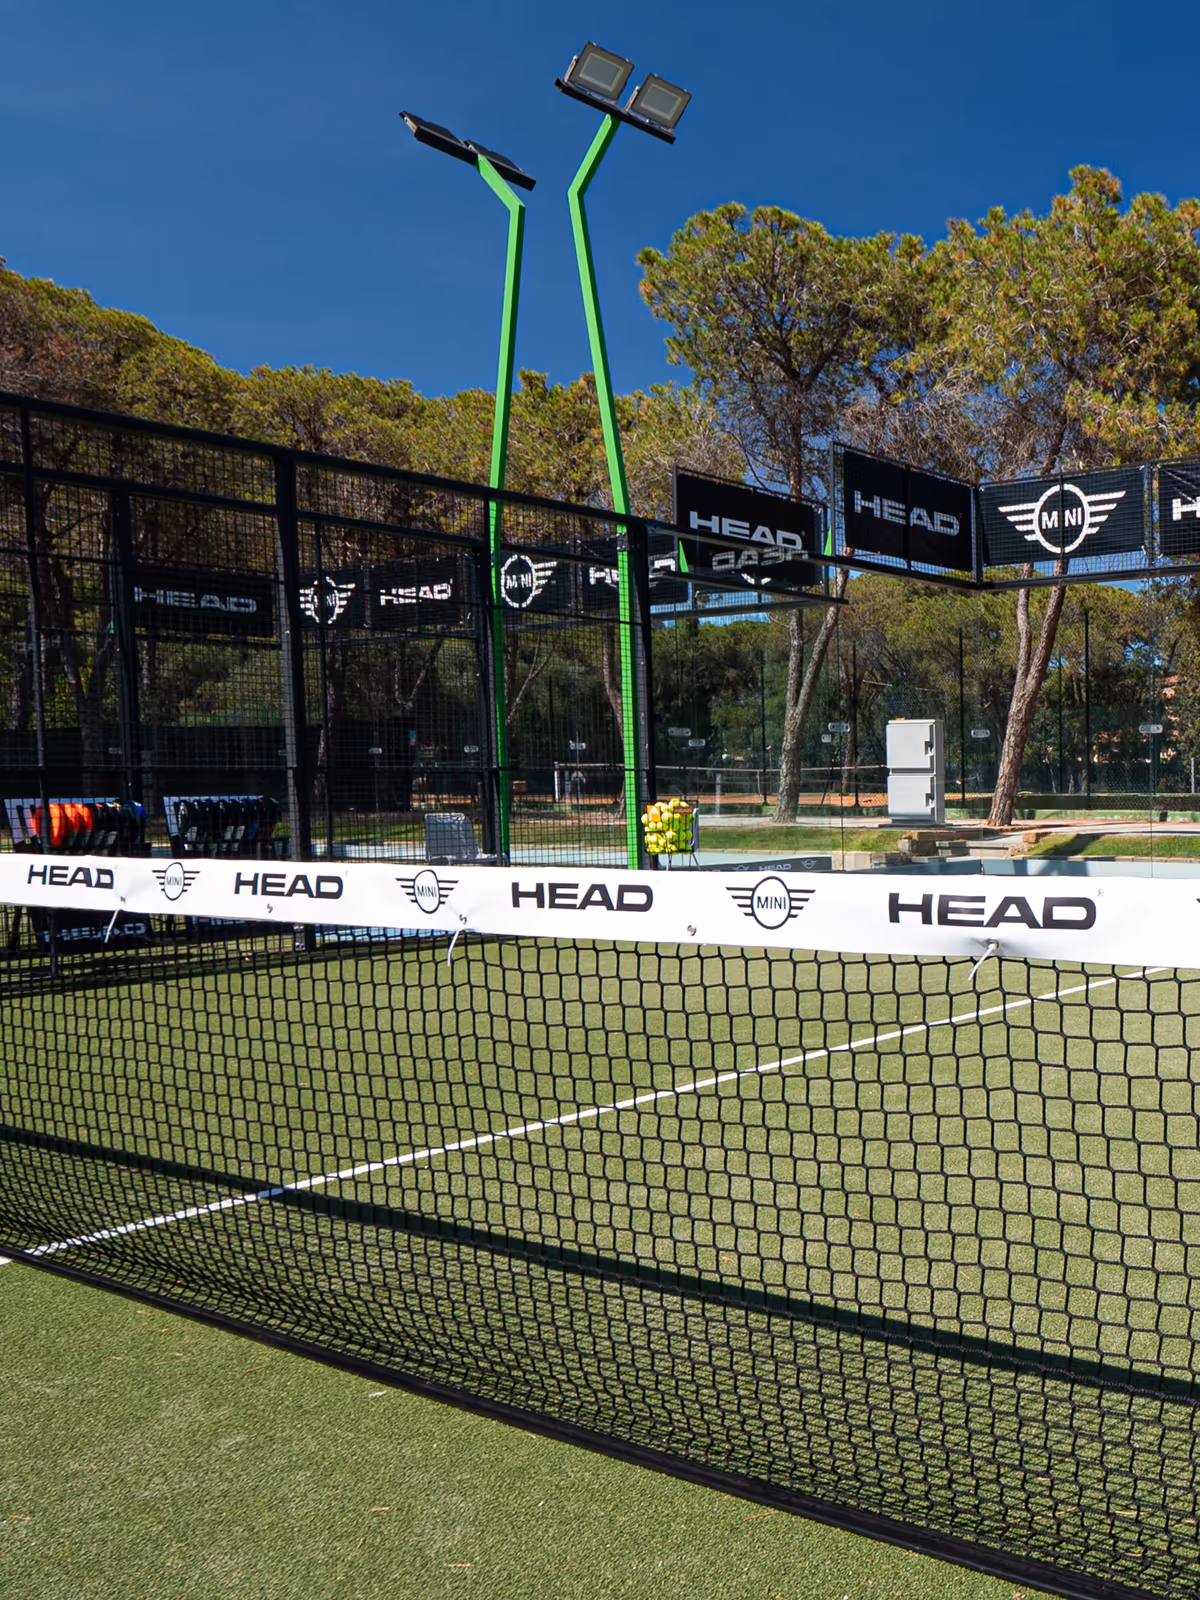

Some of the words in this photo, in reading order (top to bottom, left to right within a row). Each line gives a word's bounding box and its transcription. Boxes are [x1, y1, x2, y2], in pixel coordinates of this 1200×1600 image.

[854, 490, 959, 536] HEAD
[1042, 507, 1082, 529] MNI
[690, 511, 803, 549] HEAD
[134, 586, 257, 614] HEAD
[27, 864, 114, 889] HEAD
[234, 872, 344, 899] HEAD
[416, 885, 437, 897] MINI
[512, 881, 653, 912] HEAD
[757, 896, 787, 910] MINI
[889, 892, 1096, 930] HEAD
